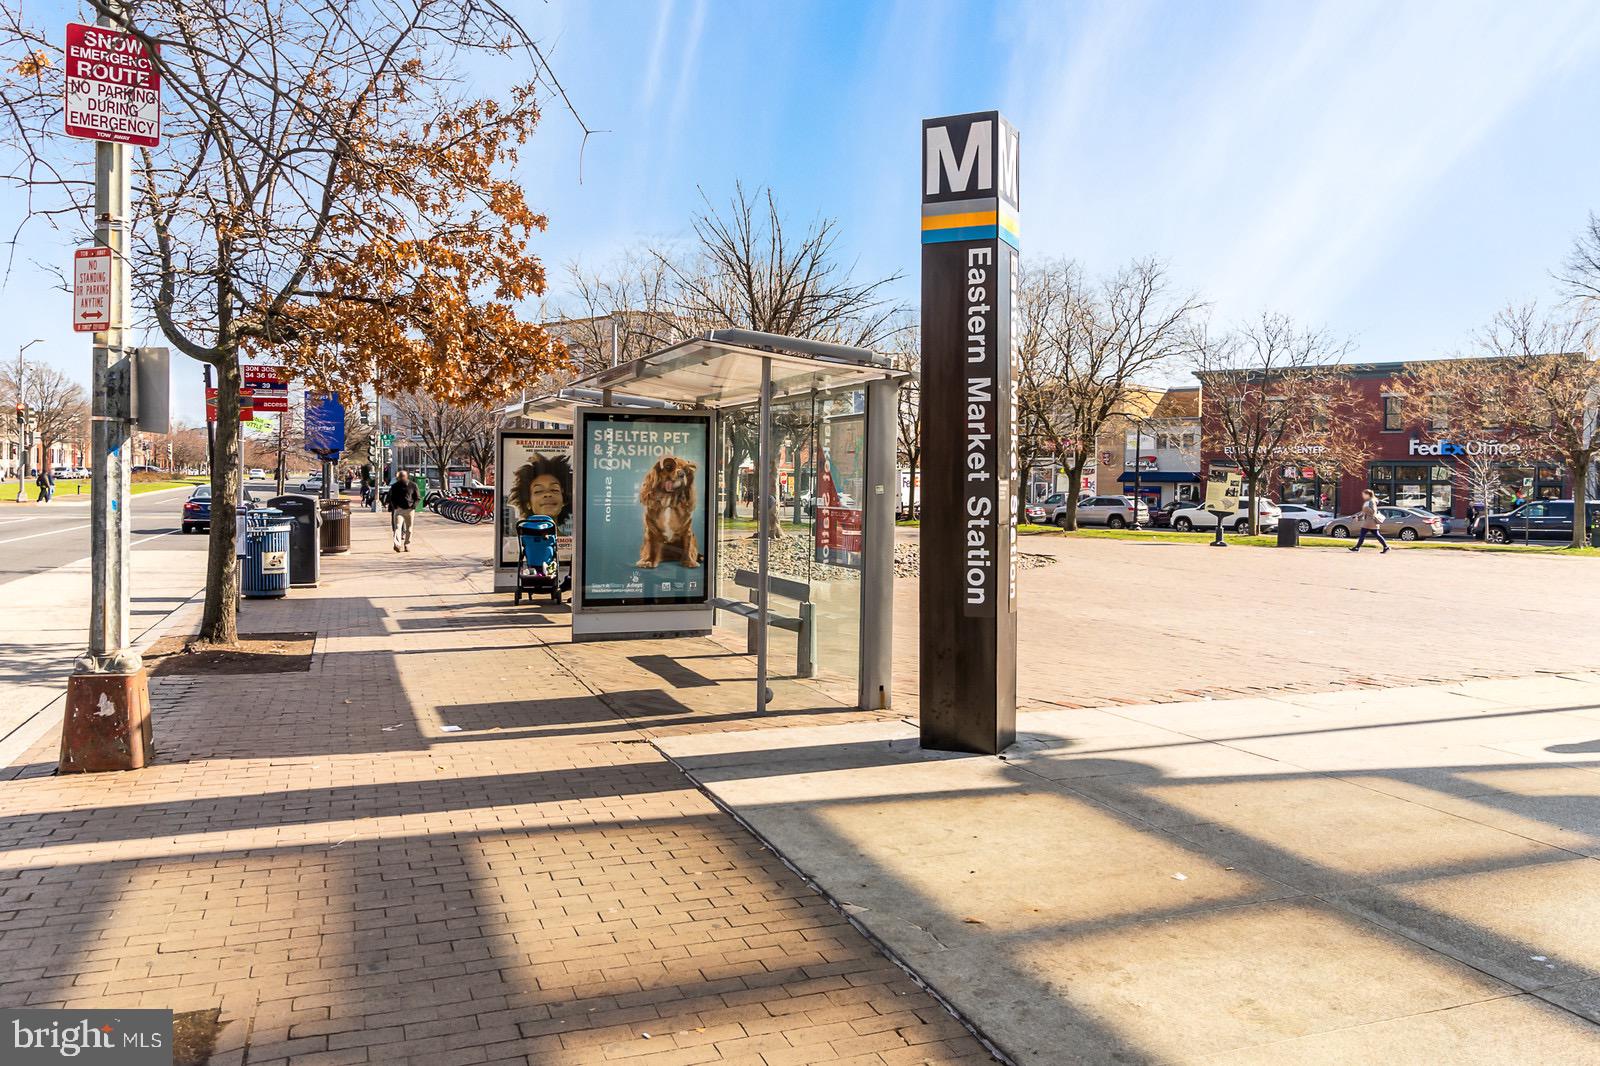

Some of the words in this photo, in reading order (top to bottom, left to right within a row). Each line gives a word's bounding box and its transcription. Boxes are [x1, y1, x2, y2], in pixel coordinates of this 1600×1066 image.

[84, 31, 142, 55] SNOW
[77, 60, 150, 87] ROUTE
[70, 79, 91, 95] NO
[97, 83, 156, 105] PARKING
[88, 97, 139, 117] DURING
[70, 111, 155, 135] EMERGENCY
[113, 132, 131, 140] AWAY
[926, 120, 992, 195] M
[1000, 121, 1018, 205] M
[88, 260, 98, 271] NO
[80, 272, 106, 284] STANDING
[76, 286, 84, 296] OR
[86, 284, 109, 296] PARKING
[80, 297, 104, 308] ANYTIME
[967, 247, 992, 363] Eastern
[594, 430, 658, 442] SHELTER
[663, 432, 690, 444] PET
[967, 377, 992, 482] Market
[594, 444, 603, 456] &
[611, 445, 674, 457] FASHION
[1409, 440, 1464, 455] FedEx
[1466, 441, 1522, 456] Office
[593, 458, 632, 470] ICON
[966, 496, 992, 604] Station
